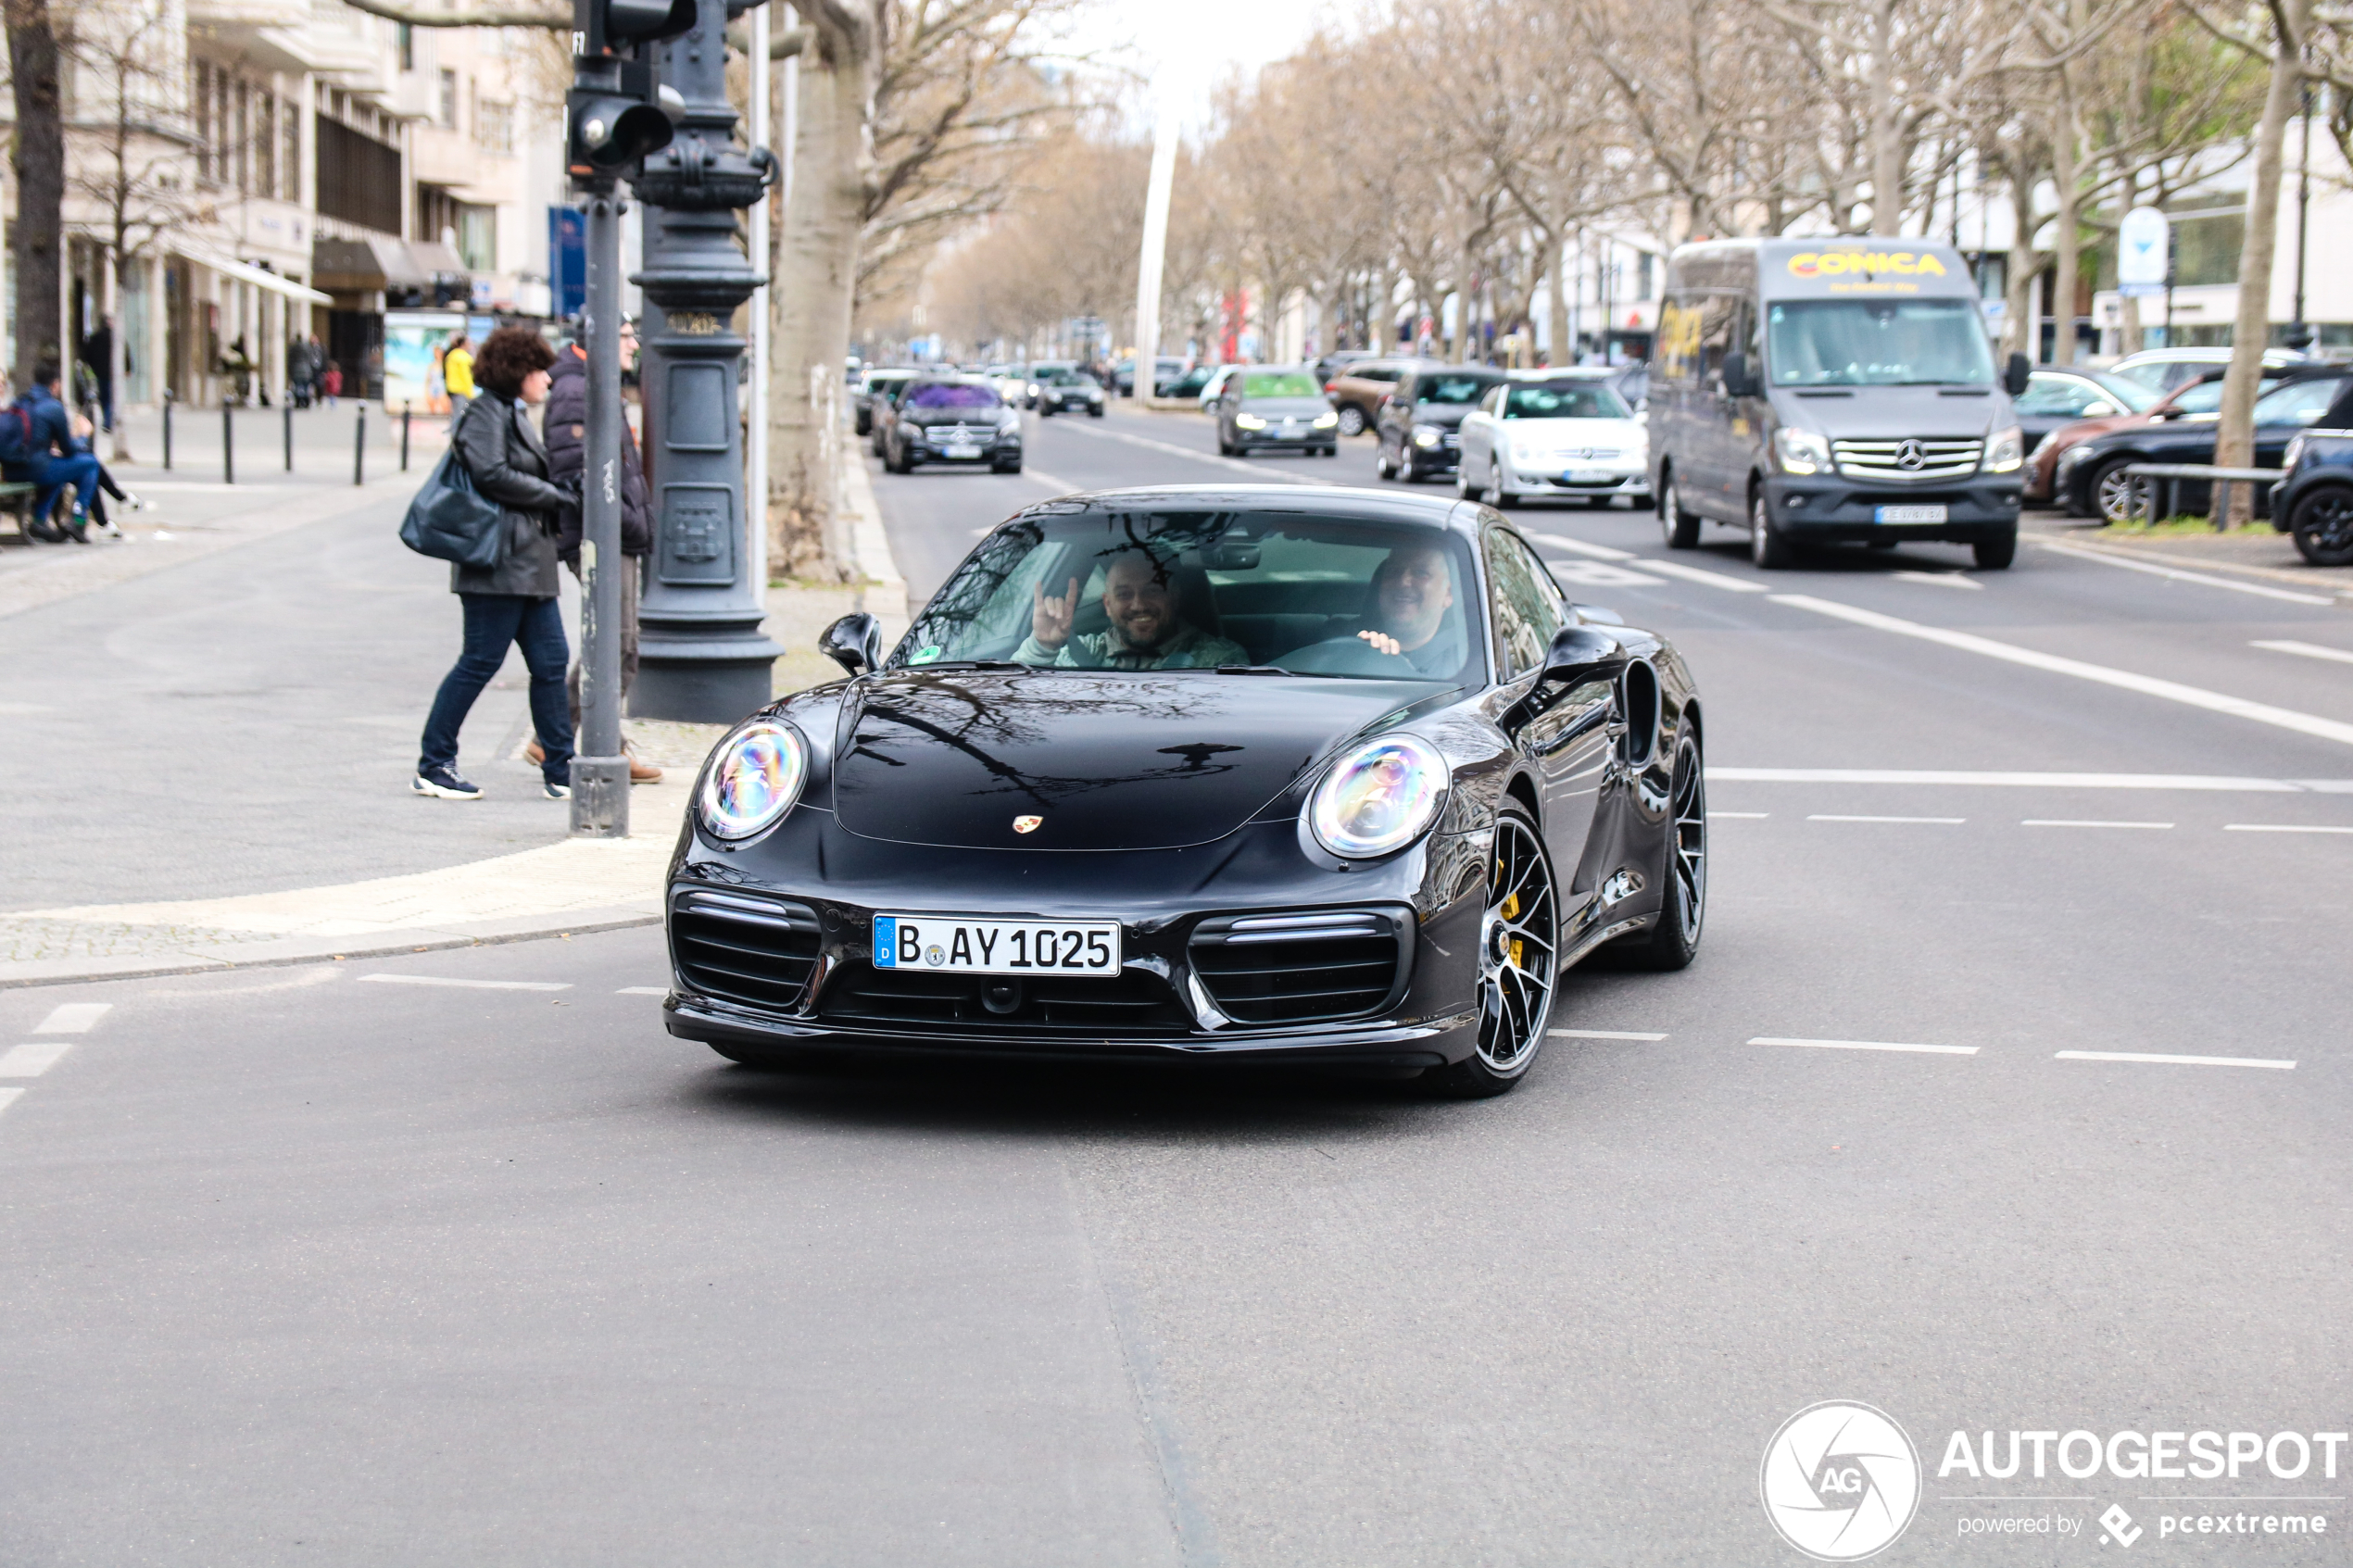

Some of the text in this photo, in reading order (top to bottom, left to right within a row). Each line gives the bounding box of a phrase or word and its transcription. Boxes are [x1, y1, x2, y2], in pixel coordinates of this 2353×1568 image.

[1788, 252, 1946, 278] CONICA
[881, 947, 889, 960] D
[899, 925, 921, 962] B
[950, 927, 999, 965] AY
[1010, 930, 1111, 968] 1025
